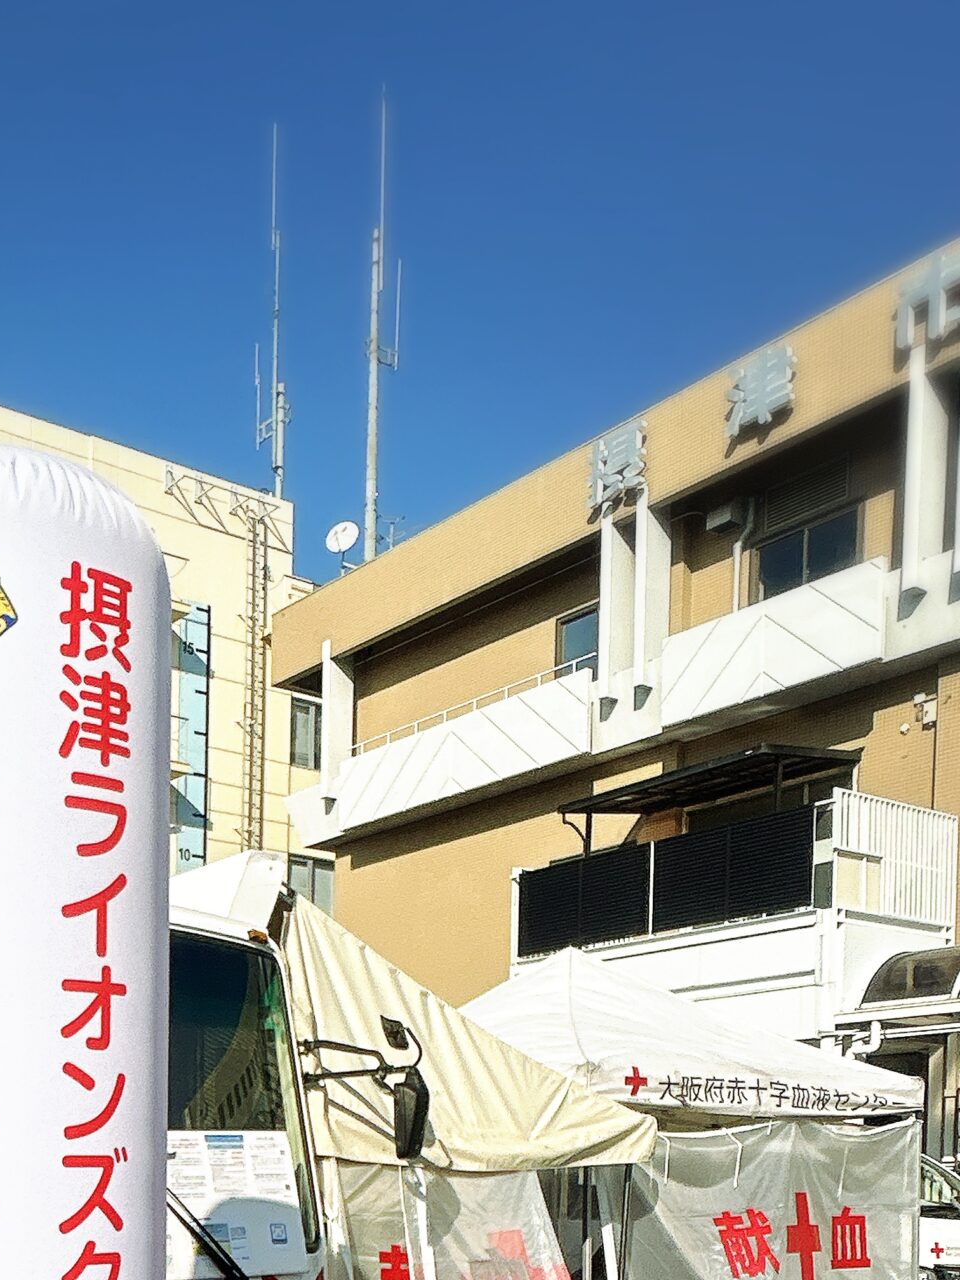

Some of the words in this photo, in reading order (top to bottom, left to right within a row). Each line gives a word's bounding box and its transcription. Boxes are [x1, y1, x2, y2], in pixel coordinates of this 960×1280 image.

[658, 1075, 906, 1112] 大阪府赤十字血液センター
